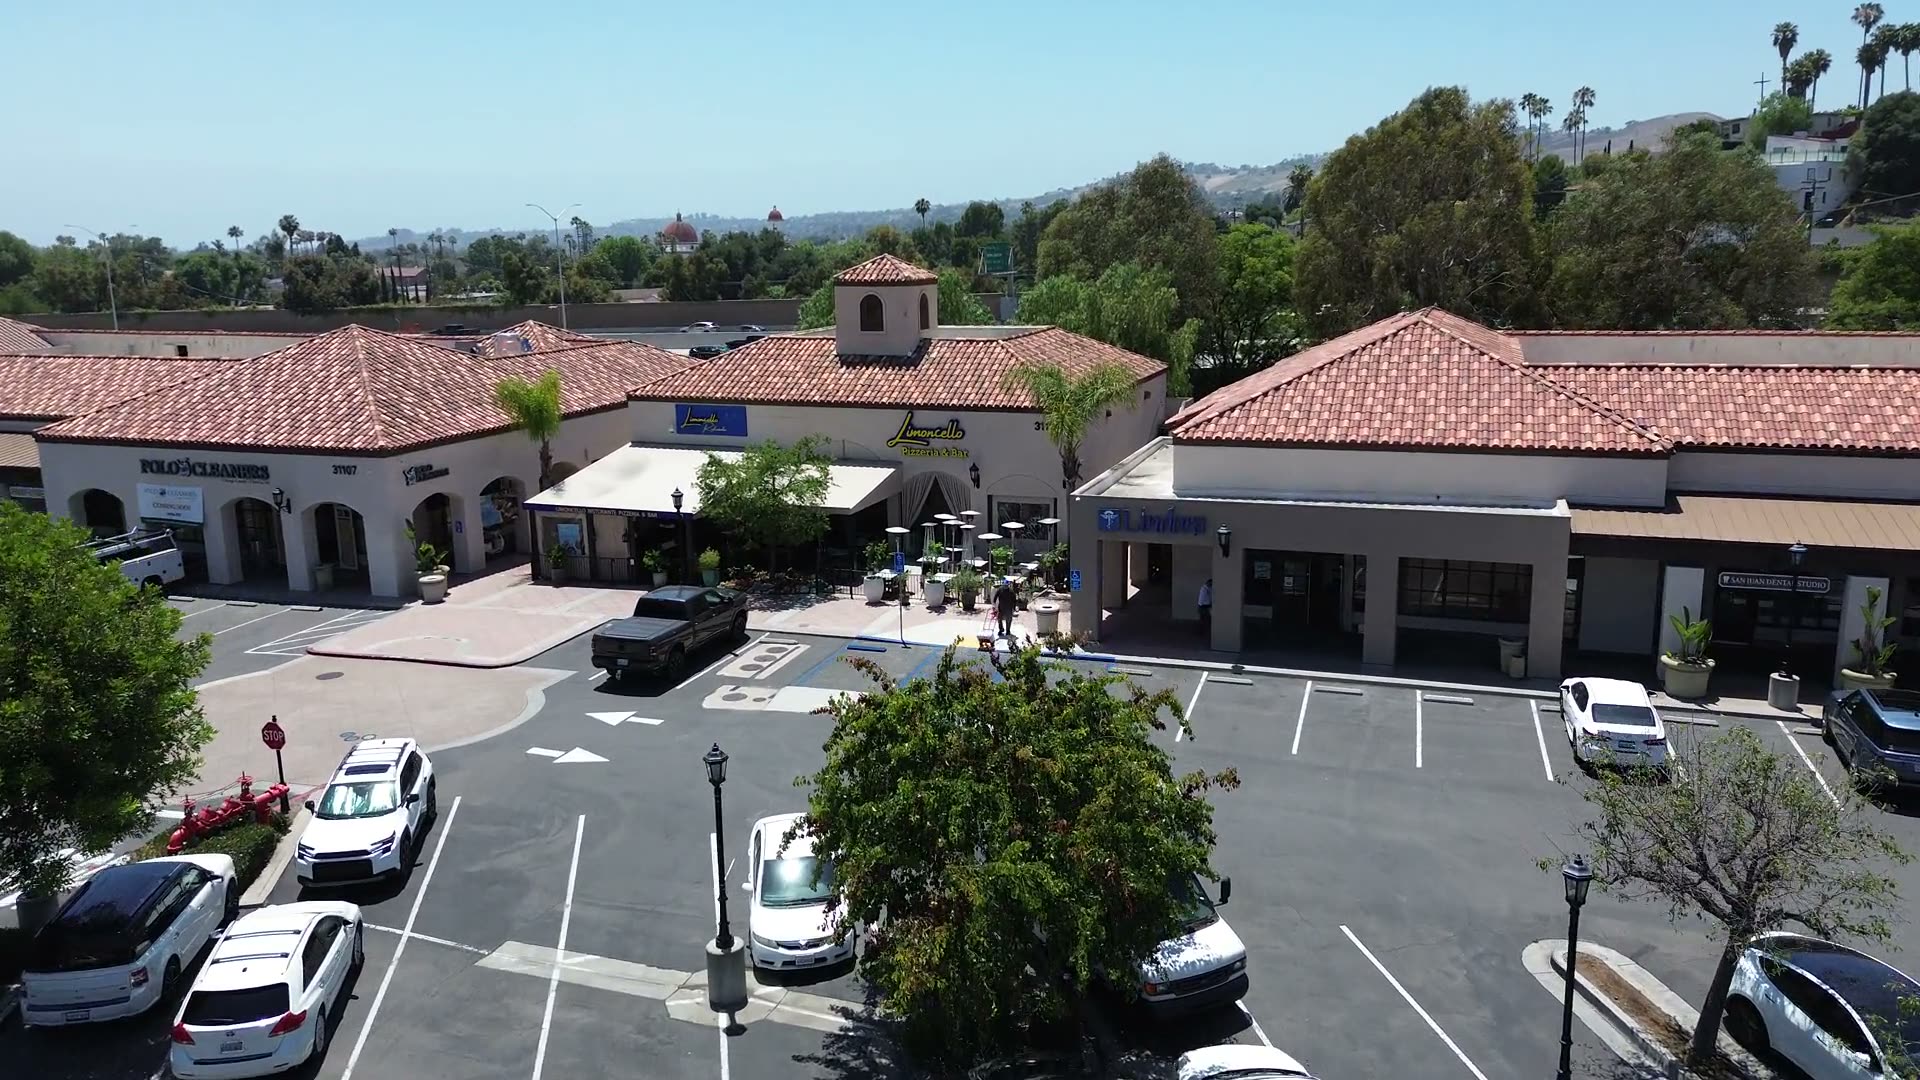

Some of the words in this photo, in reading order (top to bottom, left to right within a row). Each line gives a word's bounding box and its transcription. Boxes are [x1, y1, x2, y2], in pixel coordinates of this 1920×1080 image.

[887, 411, 966, 447] Limoncello
[902, 446, 940, 457] Pizzeria
[942, 448, 950, 457] &
[951, 448, 969, 458] Bar
[139, 458, 179, 475] POLO
[191, 462, 270, 480] CLEANERS
[332, 464, 357, 475] 31107
[1797, 580, 1827, 589] STUDIO
[263, 729, 284, 741] STOP
